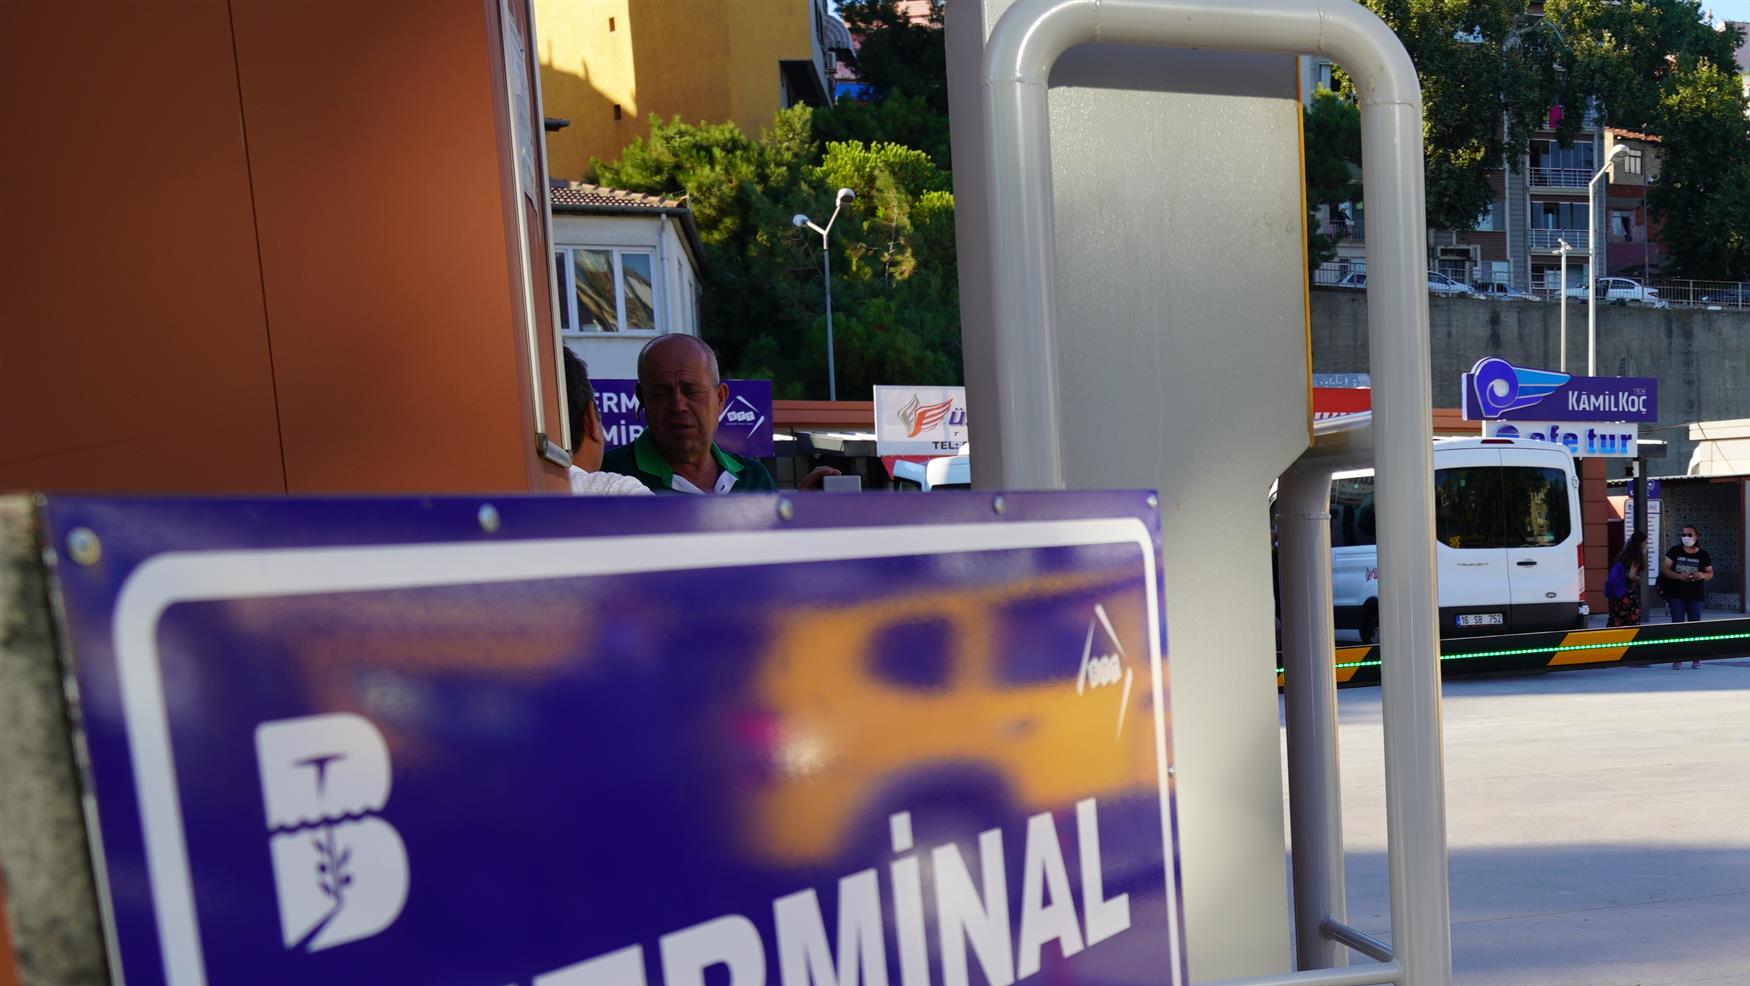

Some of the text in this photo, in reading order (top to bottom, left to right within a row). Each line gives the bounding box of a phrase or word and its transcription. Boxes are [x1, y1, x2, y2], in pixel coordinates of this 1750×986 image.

[1587, 428, 1632, 455] tur
[1461, 615, 1469, 624] 16
[1488, 614, 1502, 624] 752
